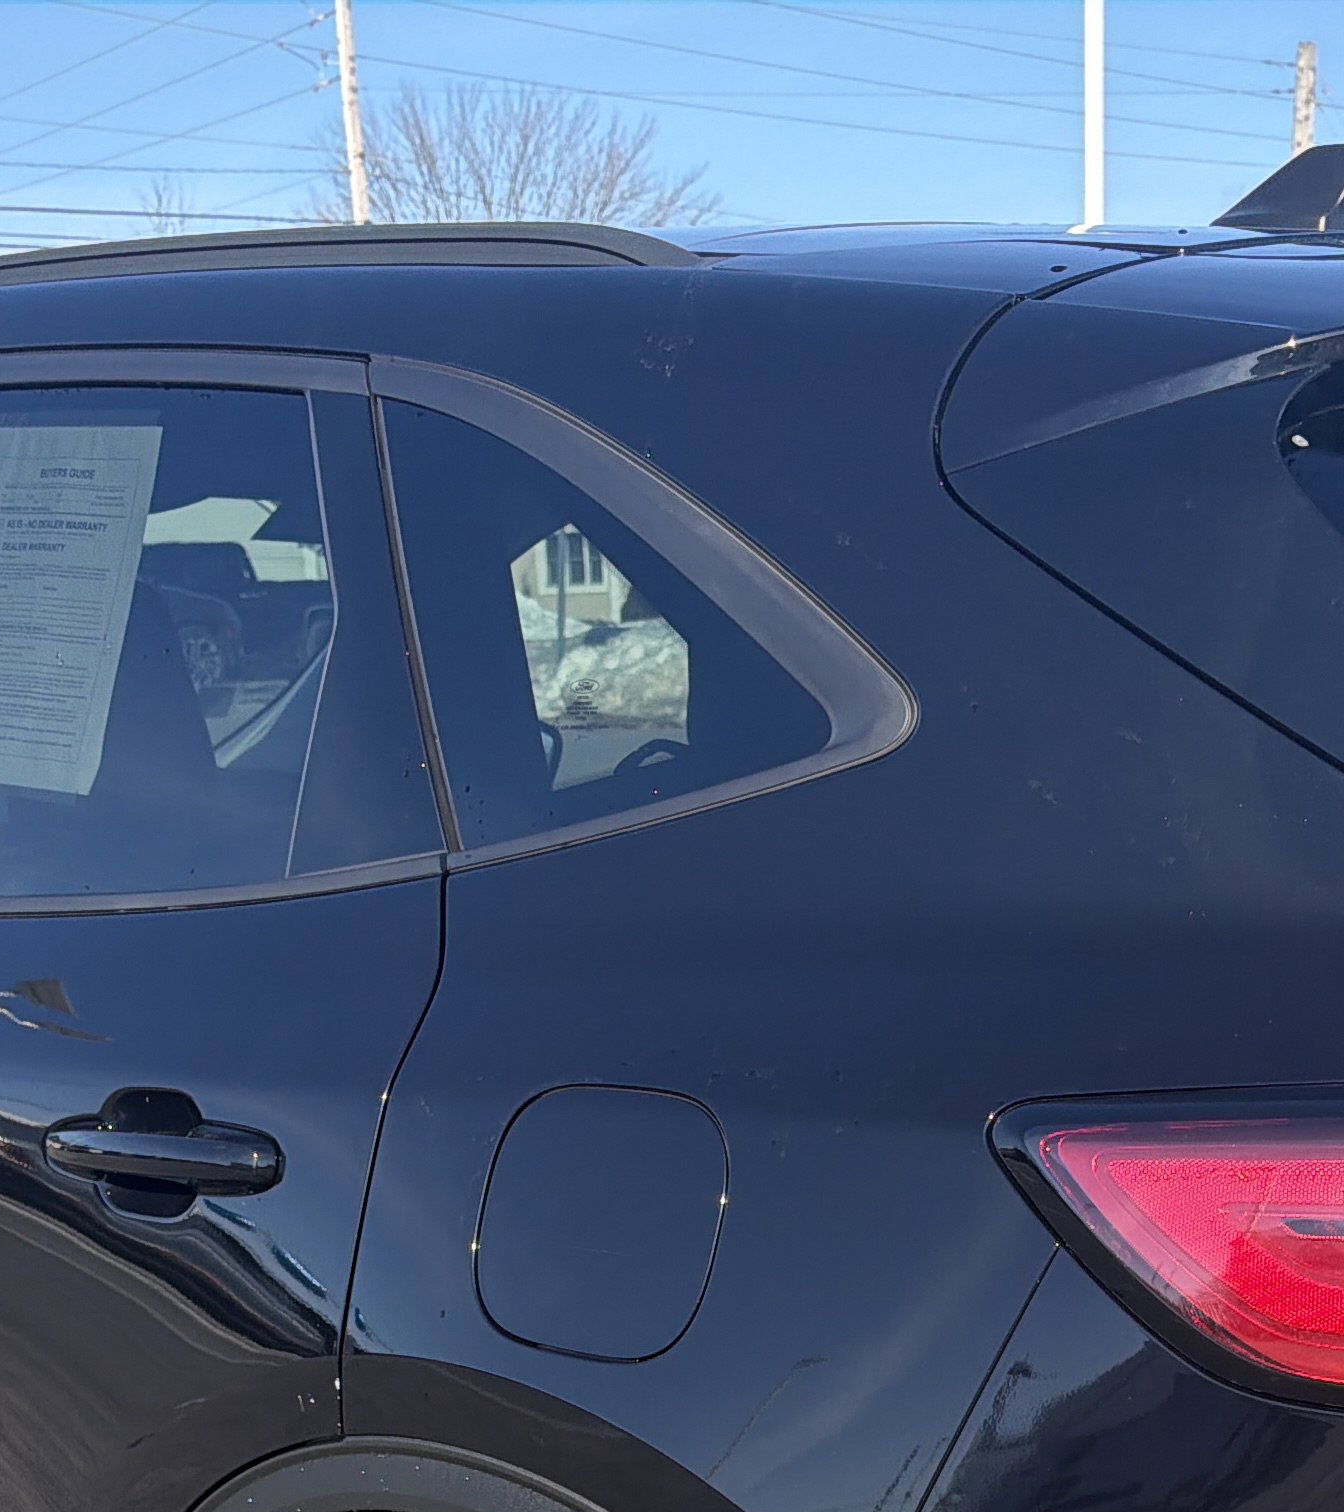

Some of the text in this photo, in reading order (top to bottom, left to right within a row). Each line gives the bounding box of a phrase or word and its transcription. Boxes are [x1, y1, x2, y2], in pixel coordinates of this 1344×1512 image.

[69, 468, 96, 480] GUIDE
[38, 520, 65, 530] DEALER
[65, 520, 109, 532] WARRANTY
[1, 541, 66, 552] DEALER WARRANTY
